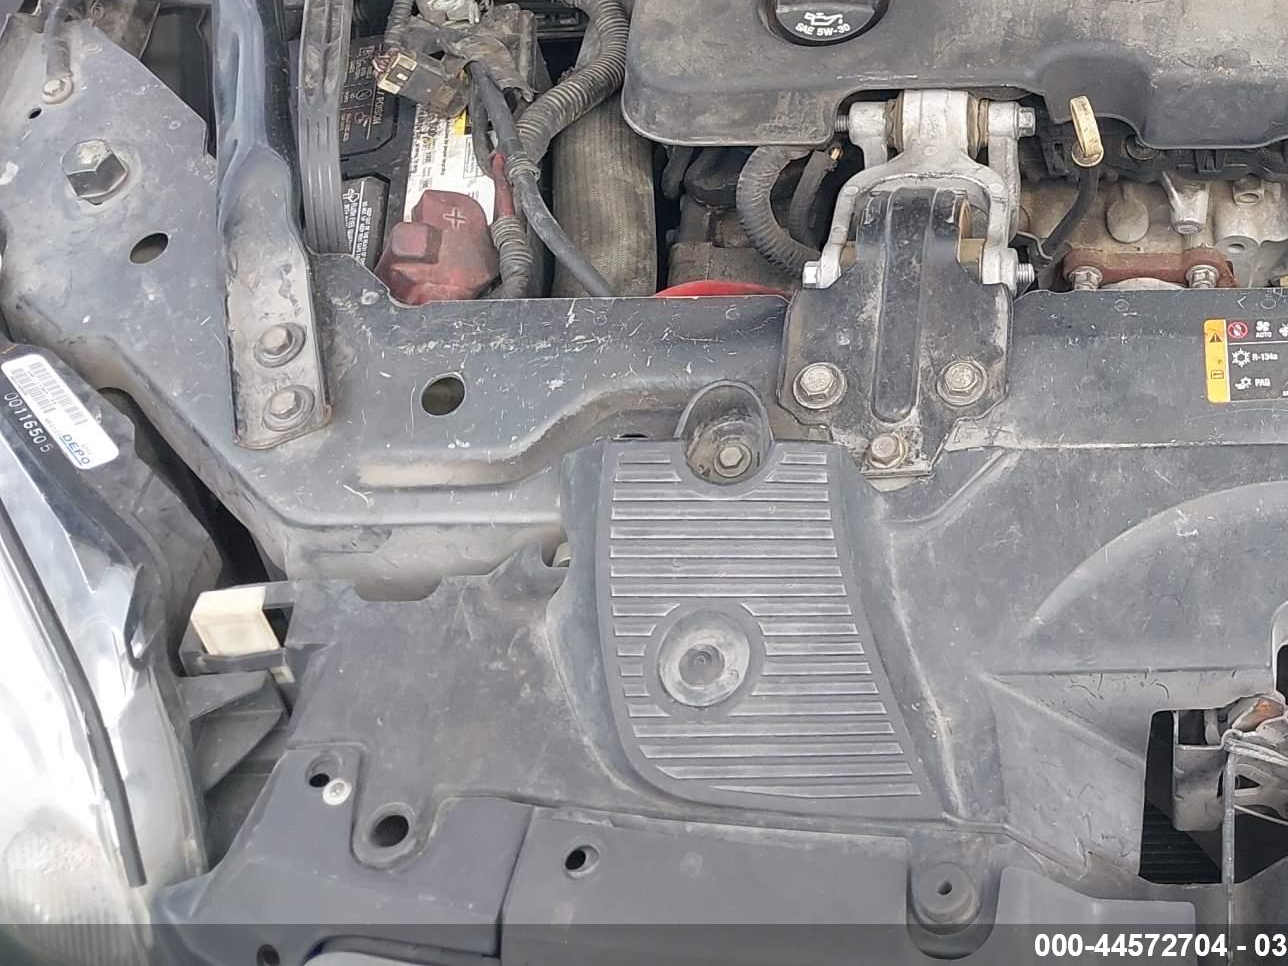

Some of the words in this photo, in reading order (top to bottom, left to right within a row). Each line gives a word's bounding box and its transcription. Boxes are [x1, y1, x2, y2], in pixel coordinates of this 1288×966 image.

[795, 22, 815, 35] SAE
[816, 23, 851, 36] 5W-30
[1252, 352, 1278, 361] R-134a
[1254, 378, 1271, 387] PAG
[62, 433, 91, 465] DEPO
